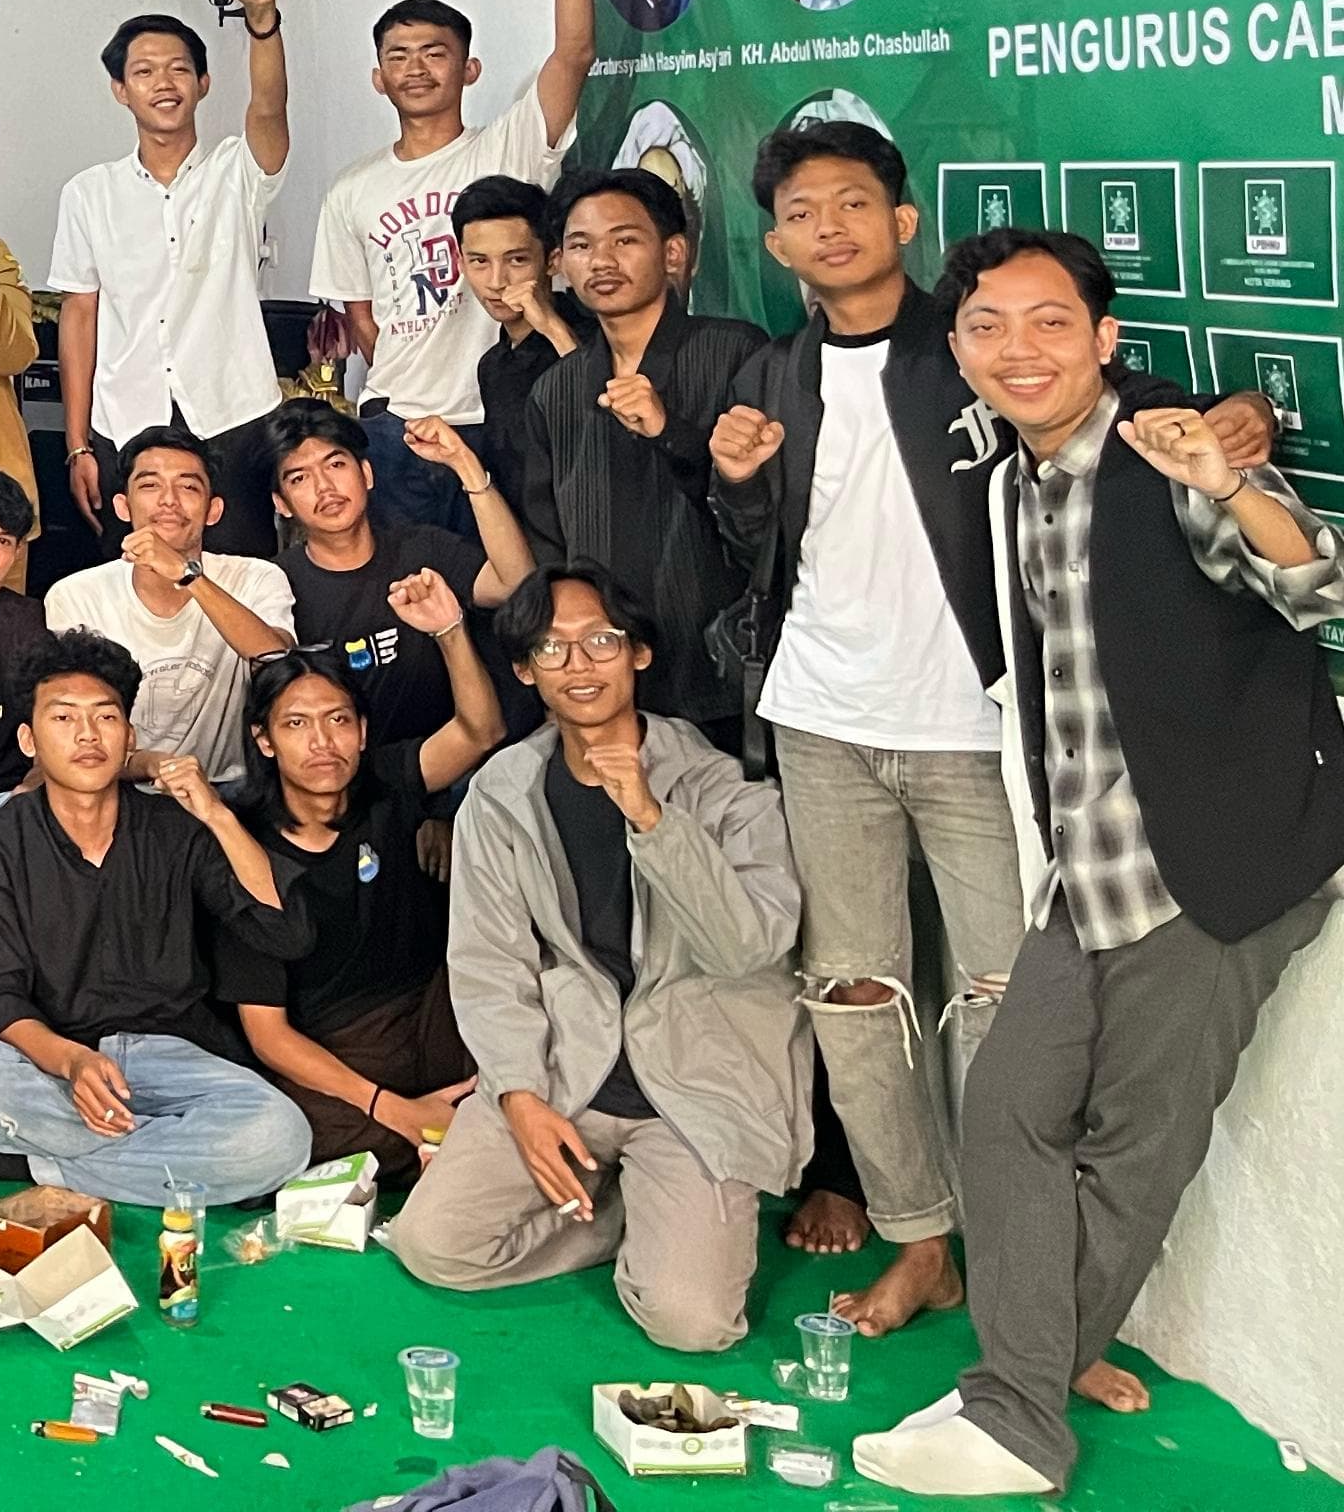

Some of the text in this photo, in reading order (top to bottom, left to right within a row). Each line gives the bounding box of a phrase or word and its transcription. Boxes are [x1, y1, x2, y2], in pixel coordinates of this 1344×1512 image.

[656, 49, 697, 75] Hasyim
[741, 28, 951, 66] KH. Abdul Wahab Chasbullah
[988, 7, 1230, 78] PENGURUS
[368, 191, 461, 250] LONDO
